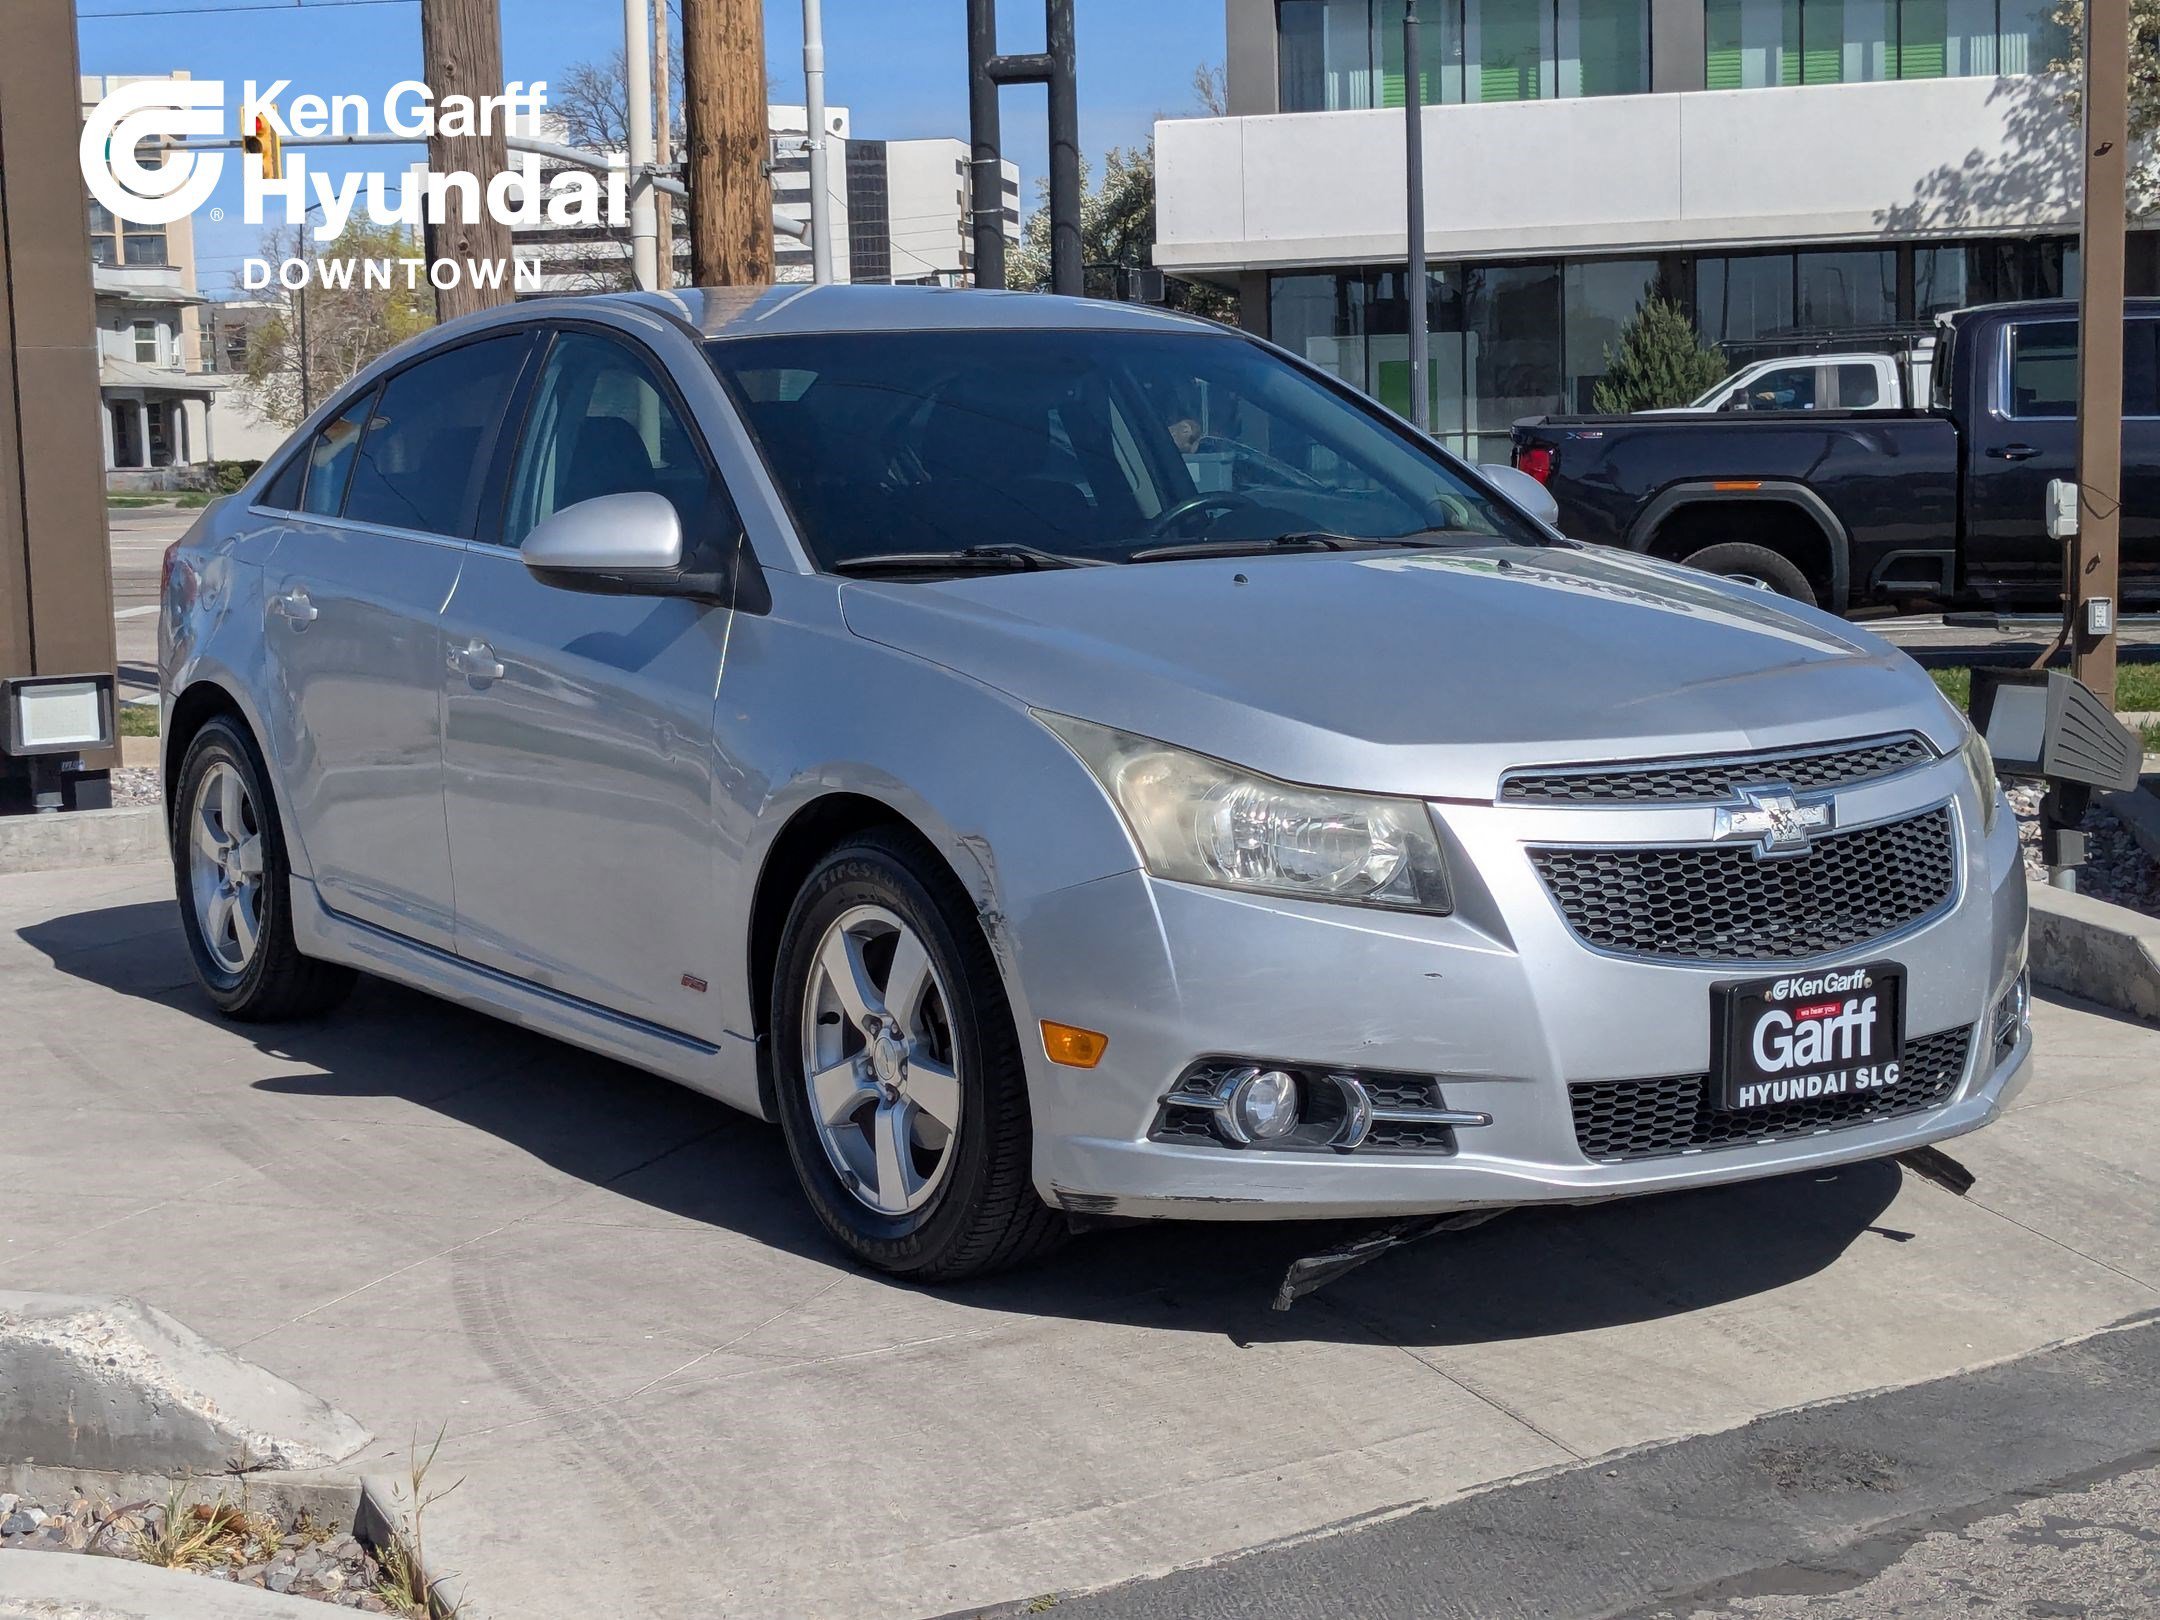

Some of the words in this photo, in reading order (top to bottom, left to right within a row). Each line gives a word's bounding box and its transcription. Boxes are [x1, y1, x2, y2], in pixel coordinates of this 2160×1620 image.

[1752, 996, 1877, 1073] Garff
[1739, 1071, 1847, 1108] HYUNDAI
[1855, 1063, 1900, 1090] SLC
